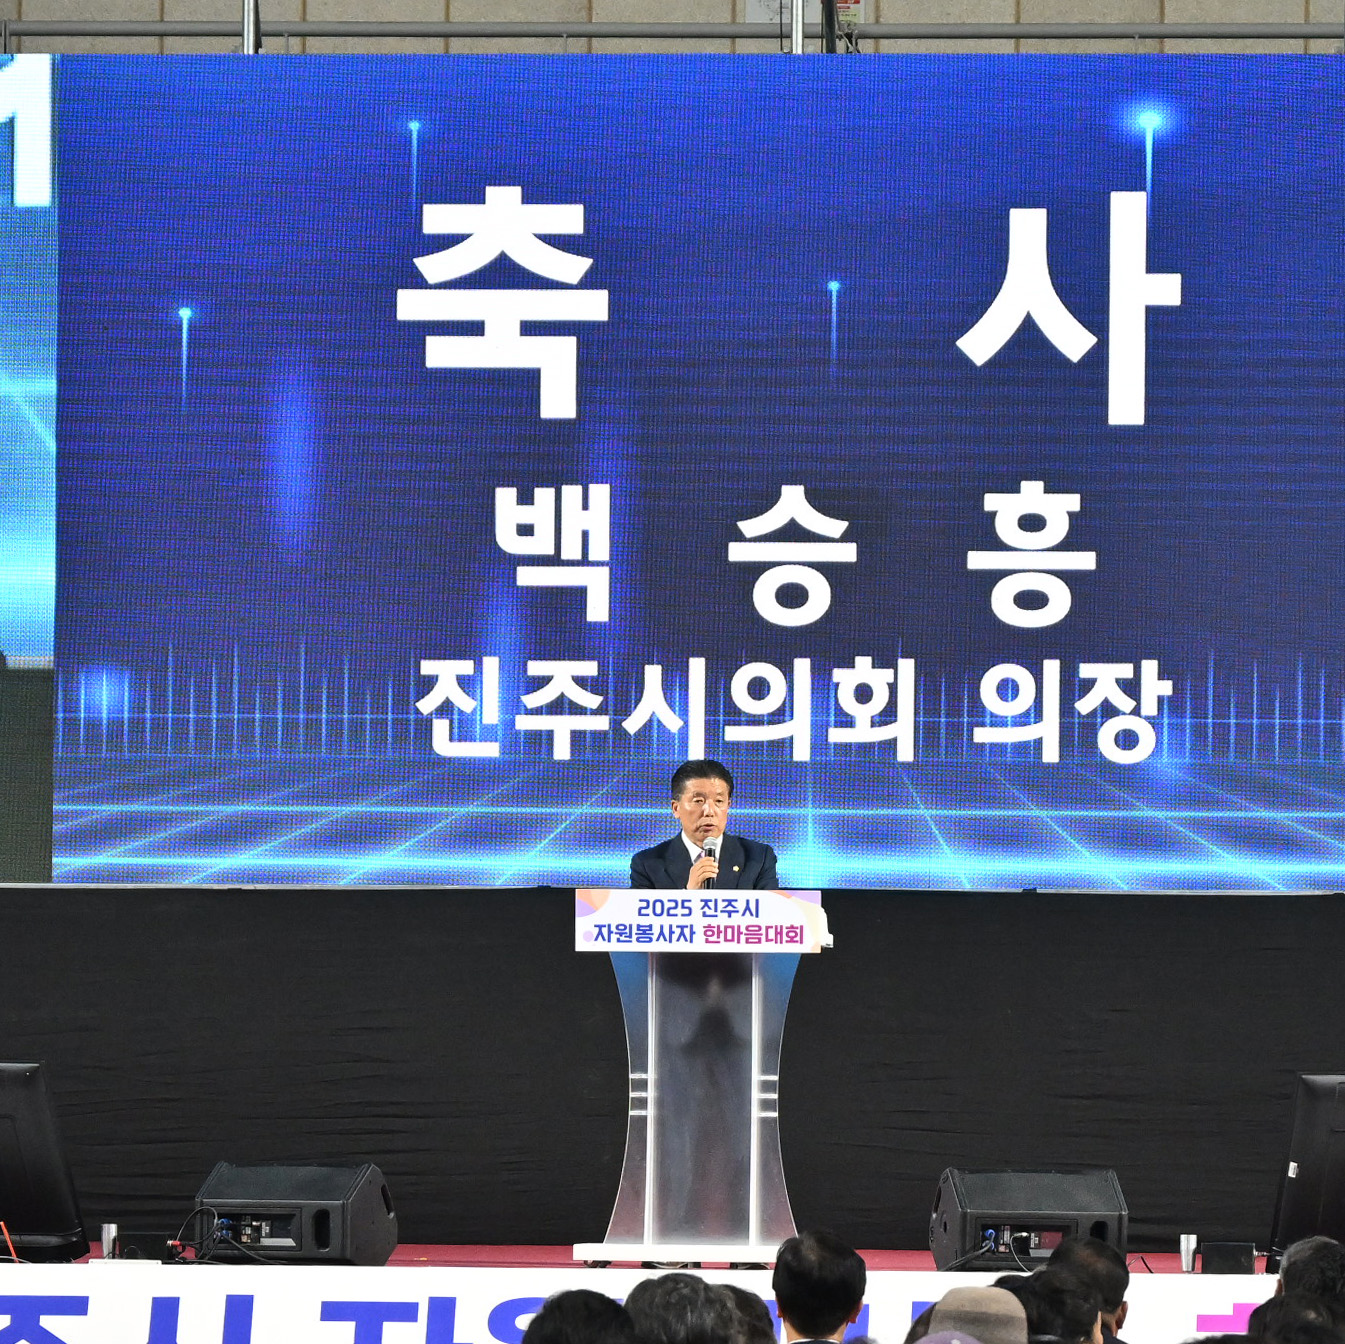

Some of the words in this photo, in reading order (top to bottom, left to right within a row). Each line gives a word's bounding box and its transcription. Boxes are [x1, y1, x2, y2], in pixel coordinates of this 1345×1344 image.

[397, 186, 609, 419] 축
[957, 191, 1182, 426] 사
[495, 483, 611, 622] 백
[728, 485, 857, 627] 승
[967, 480, 1097, 628] 흥
[415, 655, 915, 762] 진주시의회
[972, 658, 1173, 765] 의장
[593, 923, 696, 944] 자원봉사자
[702, 924, 804, 945] 한마음대회
[637, 899, 693, 918] 2025
[699, 898, 760, 919] 진주시
